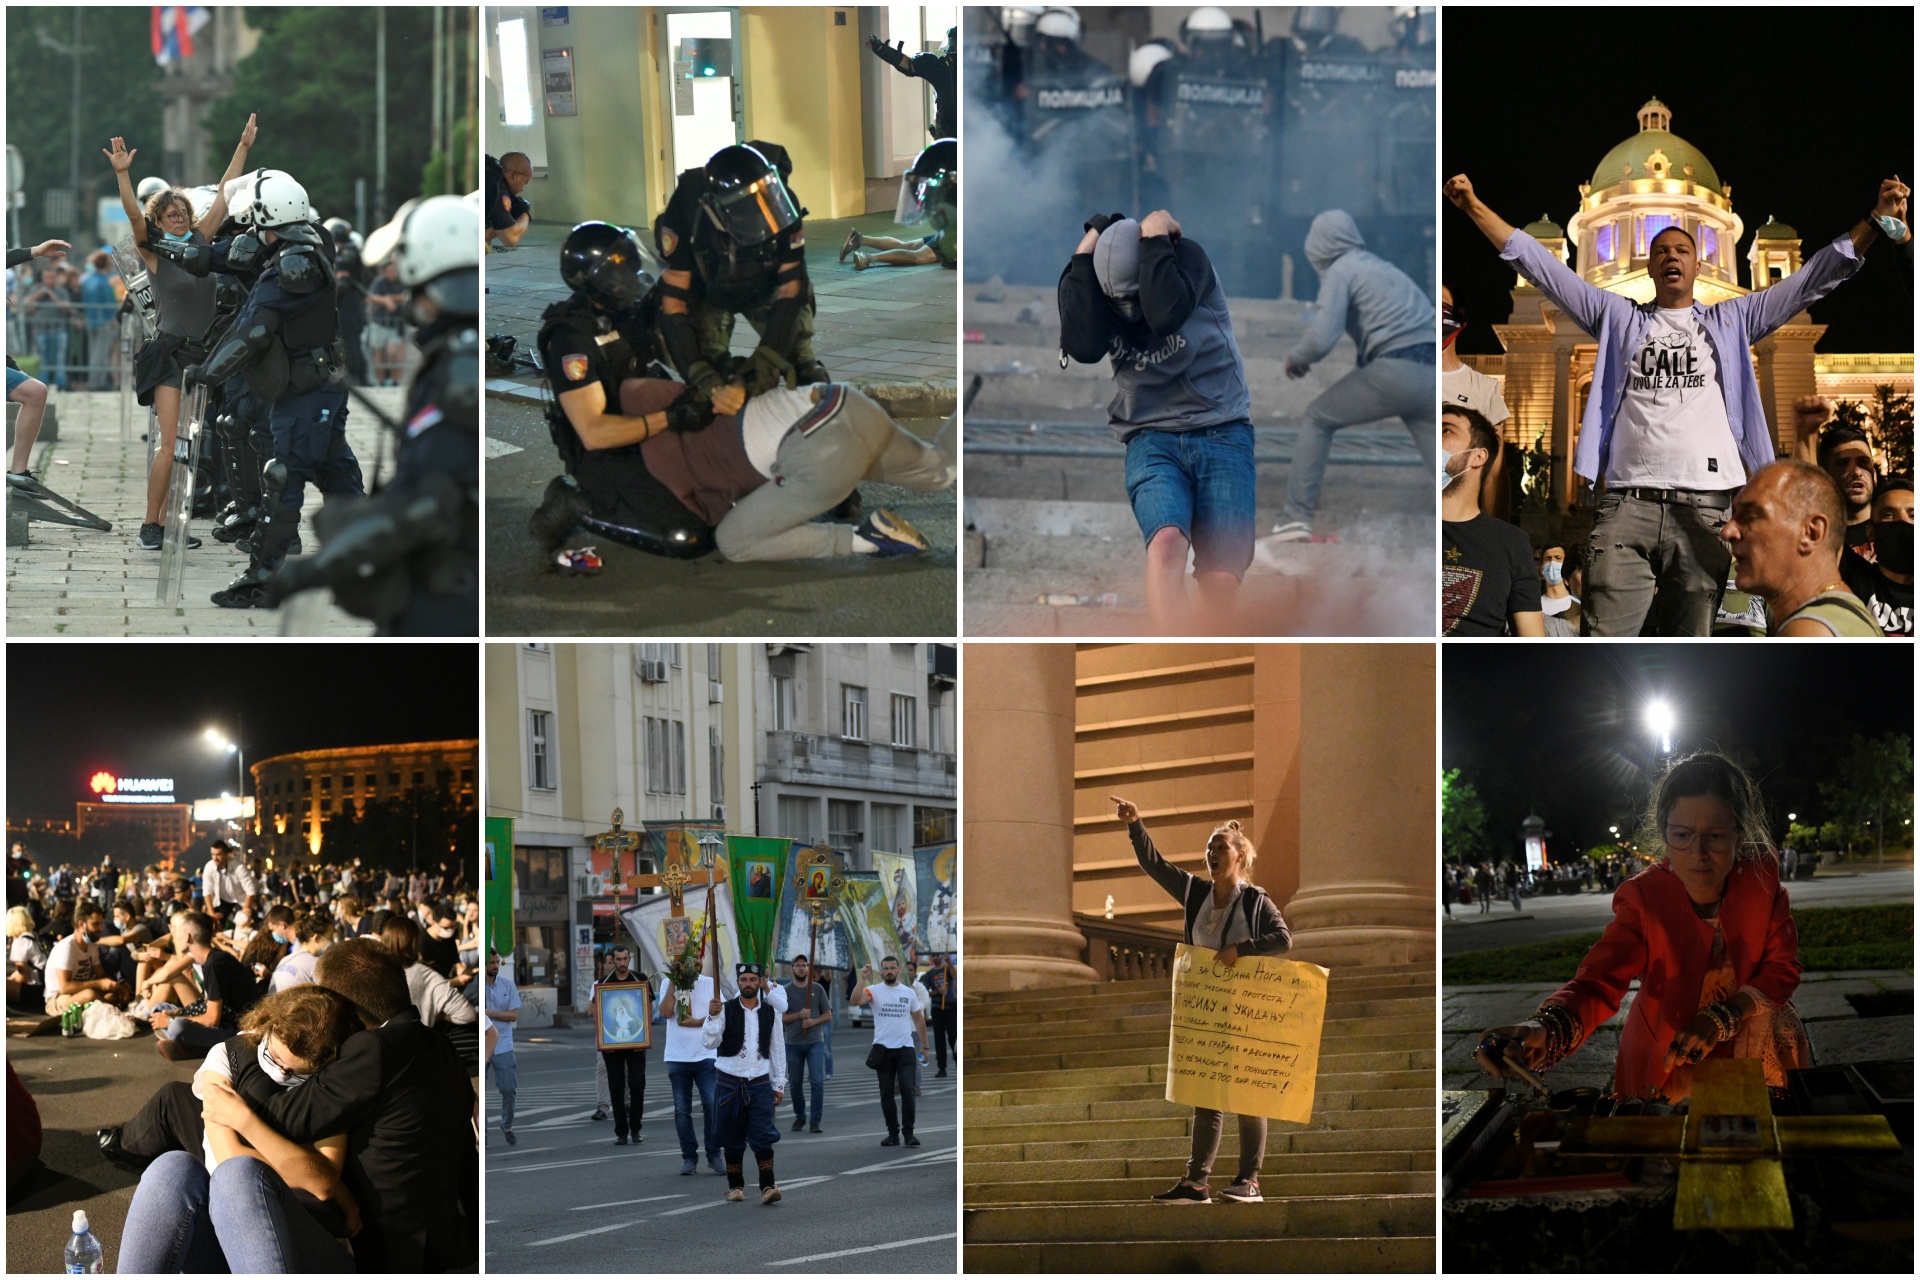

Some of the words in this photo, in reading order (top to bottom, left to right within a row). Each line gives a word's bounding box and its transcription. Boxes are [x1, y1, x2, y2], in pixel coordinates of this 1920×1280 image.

[1037, 87, 1124, 109] ПОЛИЦИЈА
[1633, 376, 1650, 390] OVO
[1652, 375, 1662, 389] JE
[1665, 376, 1679, 389] ZA
[1682, 374, 1705, 389] TEBE
[117, 778, 174, 792] HUAWEI
[1233, 1003, 1286, 1023] УКИДАЊУ
[1197, 1039, 1206, 1047] НА
[1208, 1040, 1240, 1055] ГРАЂАНЕ
[1210, 1071, 1232, 1083] 2700
[1244, 1065, 1291, 1078] ПОНИШТЕНИ
